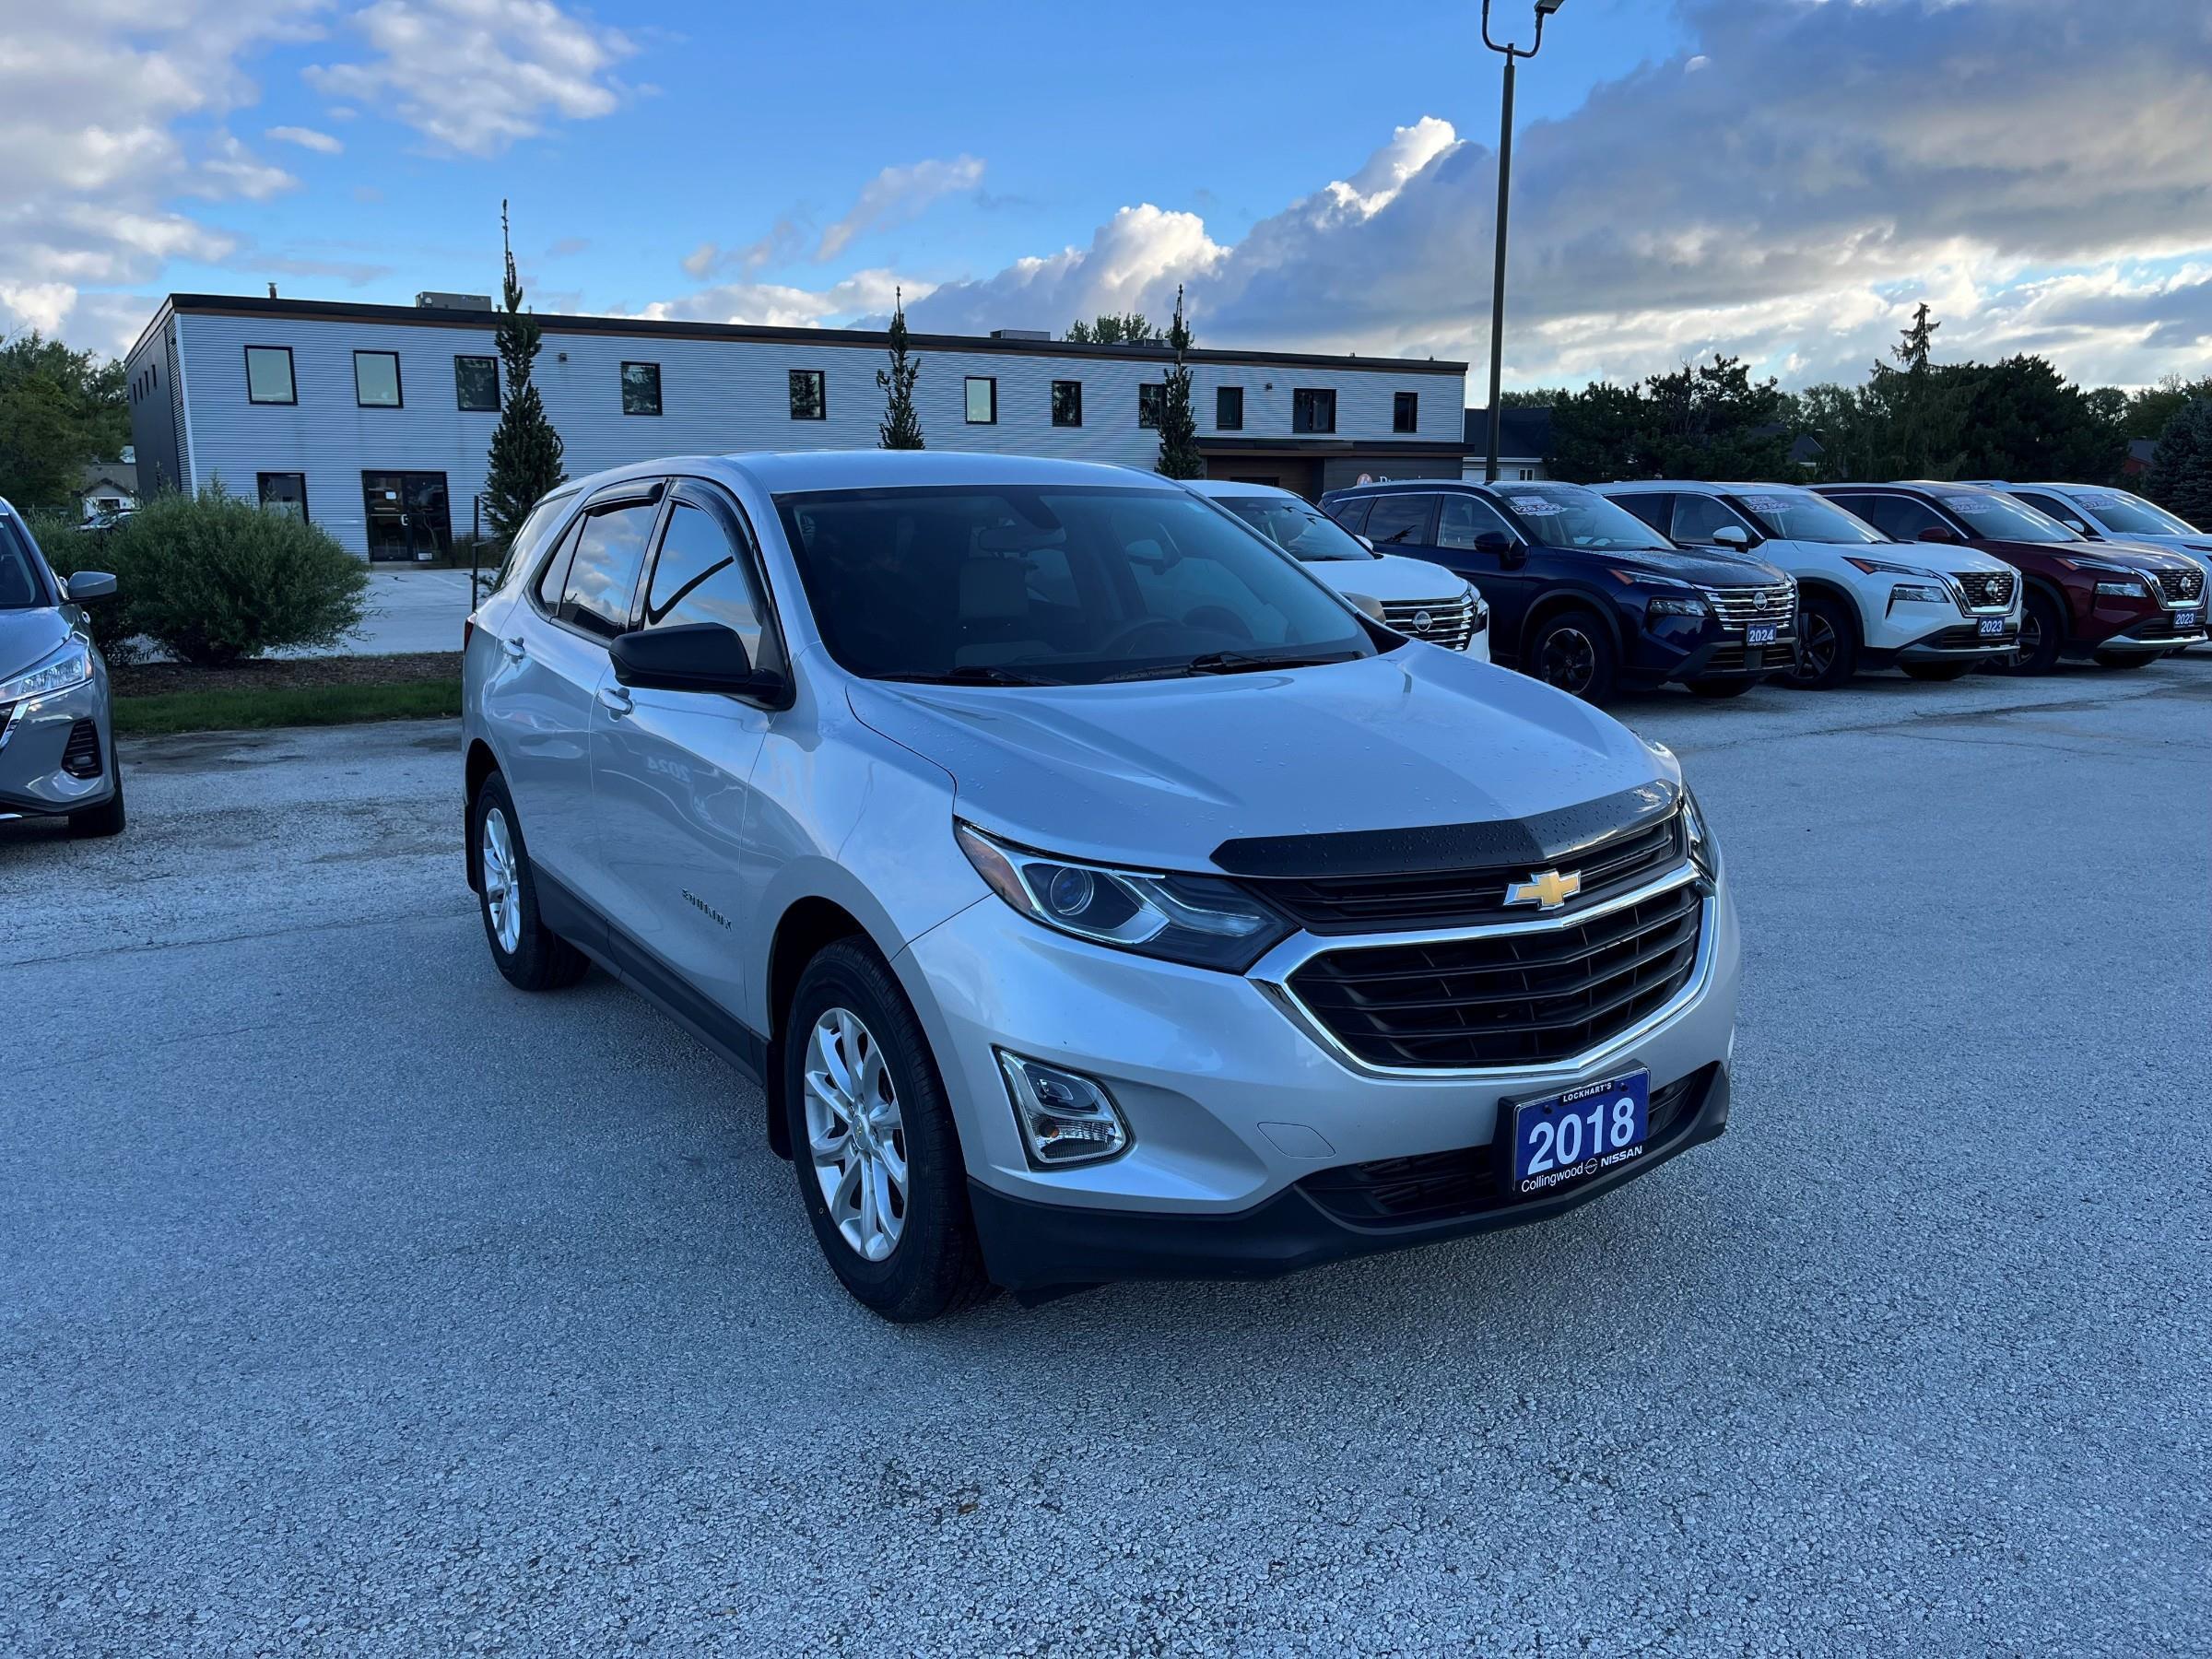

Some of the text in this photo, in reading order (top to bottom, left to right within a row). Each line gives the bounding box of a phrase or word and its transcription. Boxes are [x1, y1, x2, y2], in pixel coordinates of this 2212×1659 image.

[1981, 620, 2003, 632] 2023
[2175, 613, 2194, 624] 2023
[1749, 629, 1774, 641] 2024
[1562, 1082, 1612, 1102] LOCKHART'S
[1527, 1097, 1635, 1175] 2018
[1521, 1146, 1642, 1192] Collingwood NISSAN
